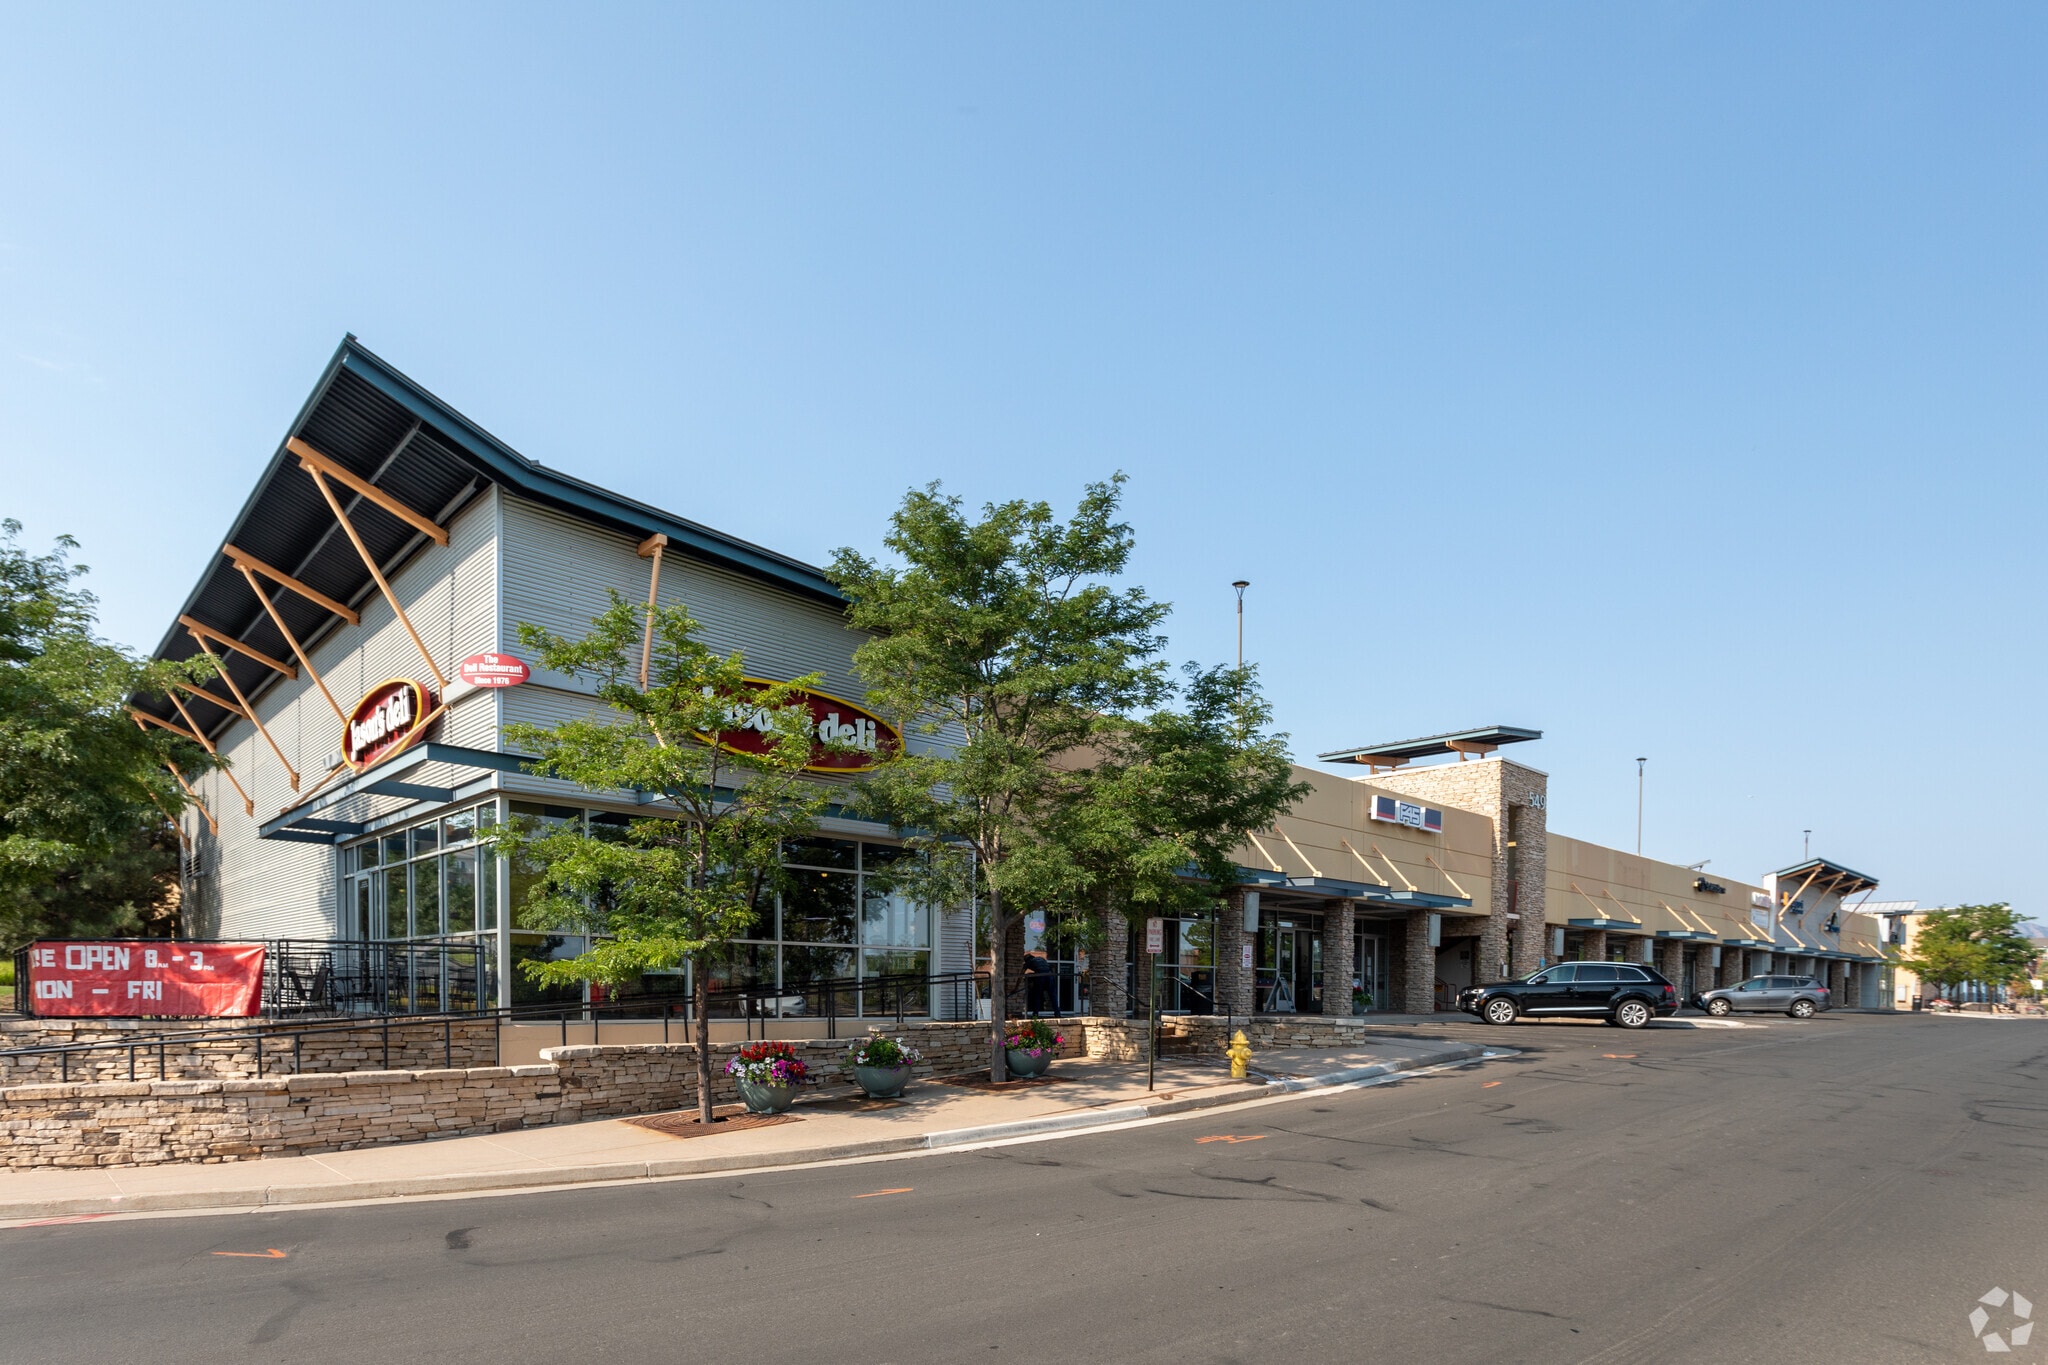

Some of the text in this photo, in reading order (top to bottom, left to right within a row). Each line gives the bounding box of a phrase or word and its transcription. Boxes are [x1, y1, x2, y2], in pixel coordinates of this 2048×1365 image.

[483, 654, 499, 664] The
[479, 663, 523, 674] Restaurant
[474, 676, 492, 685] Since
[819, 712, 876, 751] deli
[65, 944, 130, 971] OPEN
[127, 981, 162, 1000] FRI
